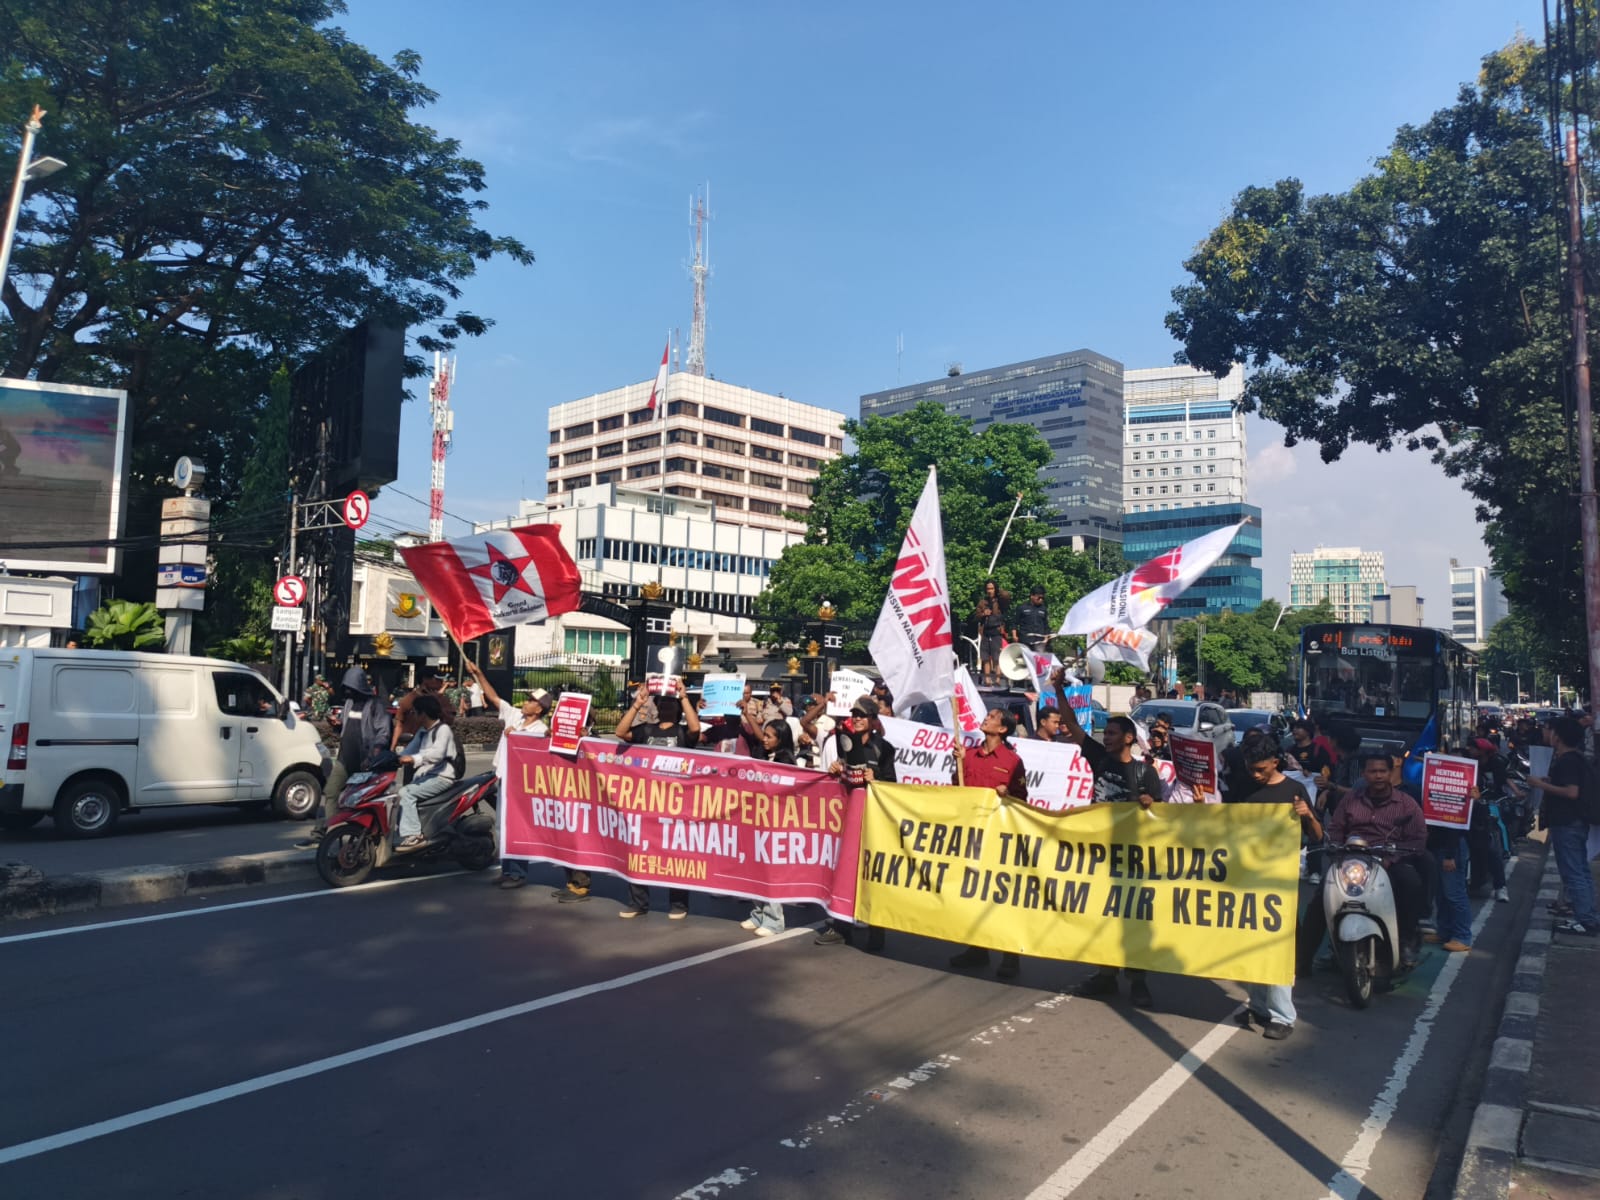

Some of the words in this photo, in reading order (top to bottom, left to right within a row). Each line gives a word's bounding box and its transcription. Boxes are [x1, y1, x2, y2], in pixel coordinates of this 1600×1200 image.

[901, 619, 924, 669] NASIONAL
[1341, 646, 1358, 656] Bus
[1360, 647, 1390, 657] Listrik
[522, 763, 591, 800] LAWAN
[596, 773, 683, 815] PERANG
[692, 784, 843, 833] IMPERIALIS
[531, 798, 591, 834] REBUT
[598, 807, 649, 850] UPAH,
[659, 817, 746, 863] TANAH,
[899, 819, 984, 861] PERAN
[999, 832, 1043, 868] TNI
[1055, 840, 1228, 883] DIPERLUAS
[862, 849, 949, 894] RAKYAT
[960, 867, 1091, 914] DISIRAM
[1102, 884, 1156, 921] AIR
[1172, 889, 1283, 932] KERAS
